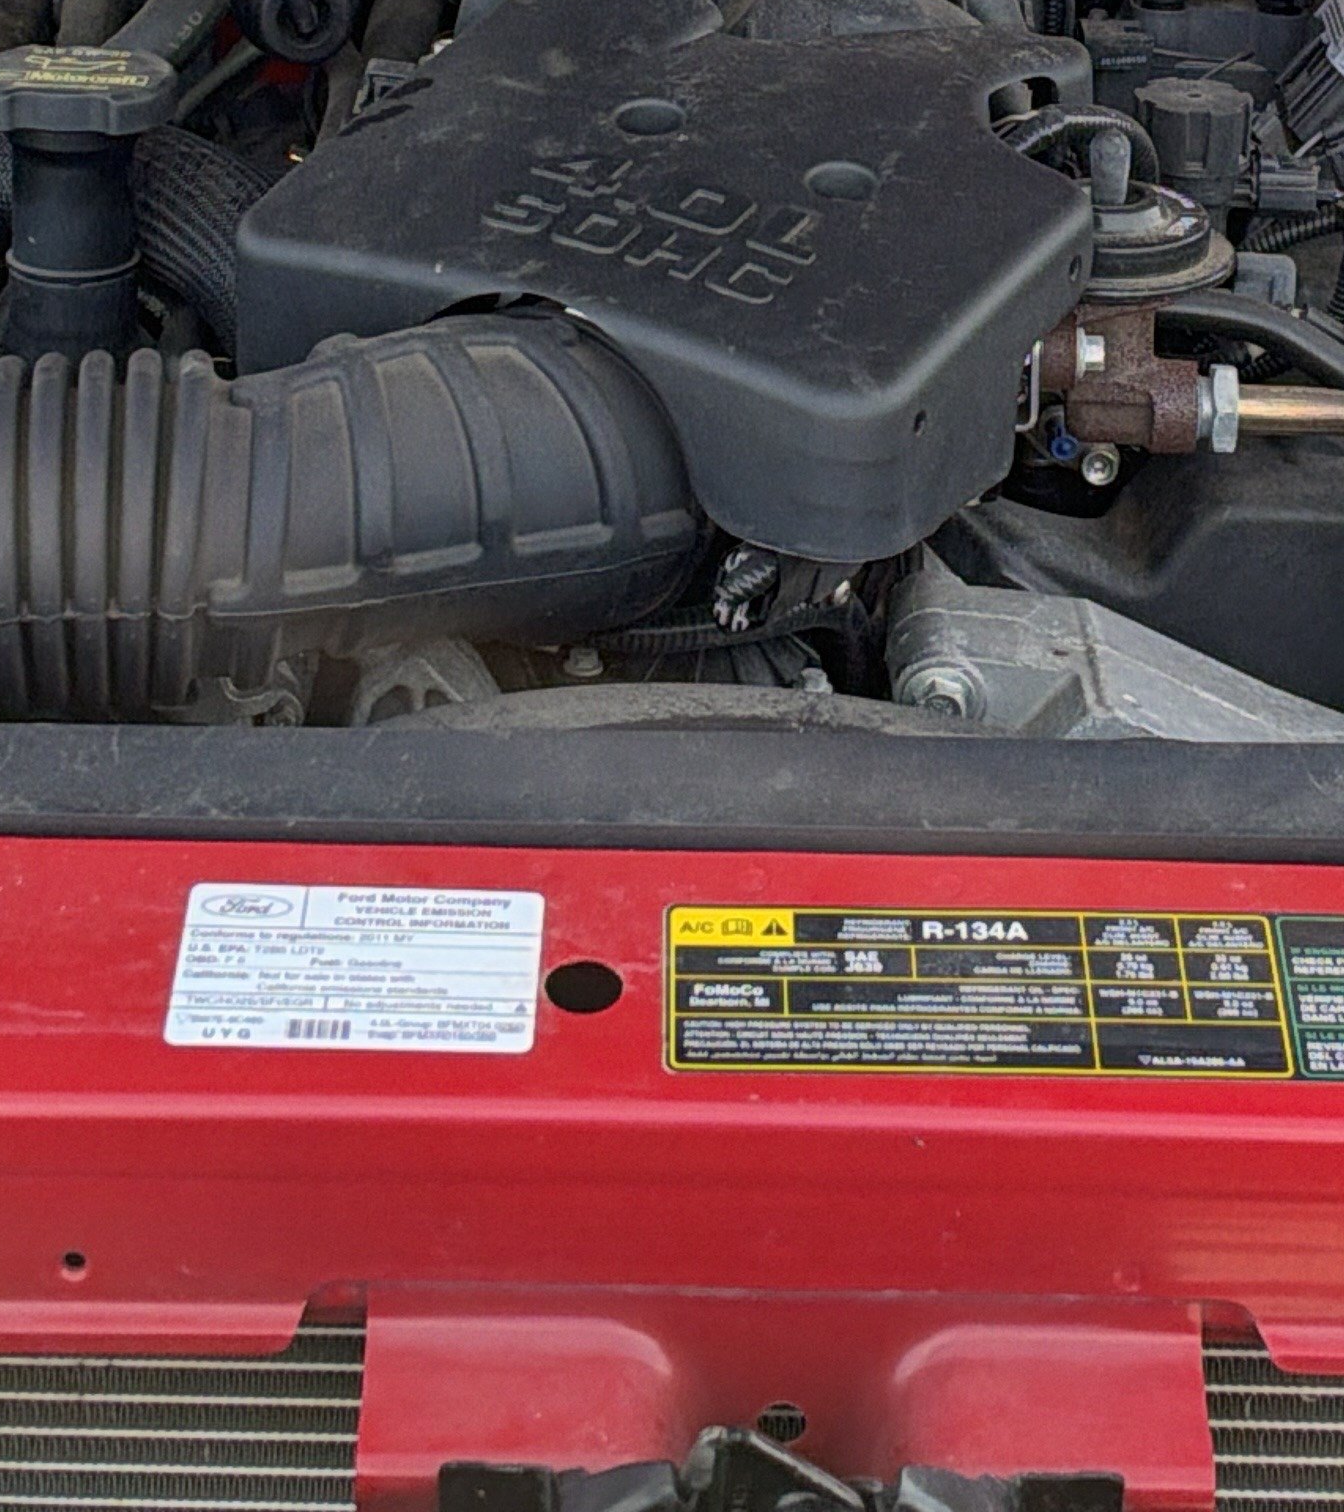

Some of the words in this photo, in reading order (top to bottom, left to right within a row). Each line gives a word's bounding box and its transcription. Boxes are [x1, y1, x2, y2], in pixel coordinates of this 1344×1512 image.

[30, 71, 137, 86] Motorcraft
[530, 158, 819, 265] 4.0L
[481, 194, 794, 304] SOHC
[219, 894, 273, 915] Ford
[337, 892, 376, 904] Ford
[382, 893, 428, 905] Motor
[434, 894, 511, 909] Company
[355, 905, 417, 917] VEHICLE
[421, 907, 492, 918] EMISSION
[334, 916, 405, 928] CONTROL
[410, 918, 510, 930] INFORMATION
[680, 920, 714, 934] A/C
[922, 920, 1029, 941] R-134A
[693, 983, 765, 996] FoMoCo
